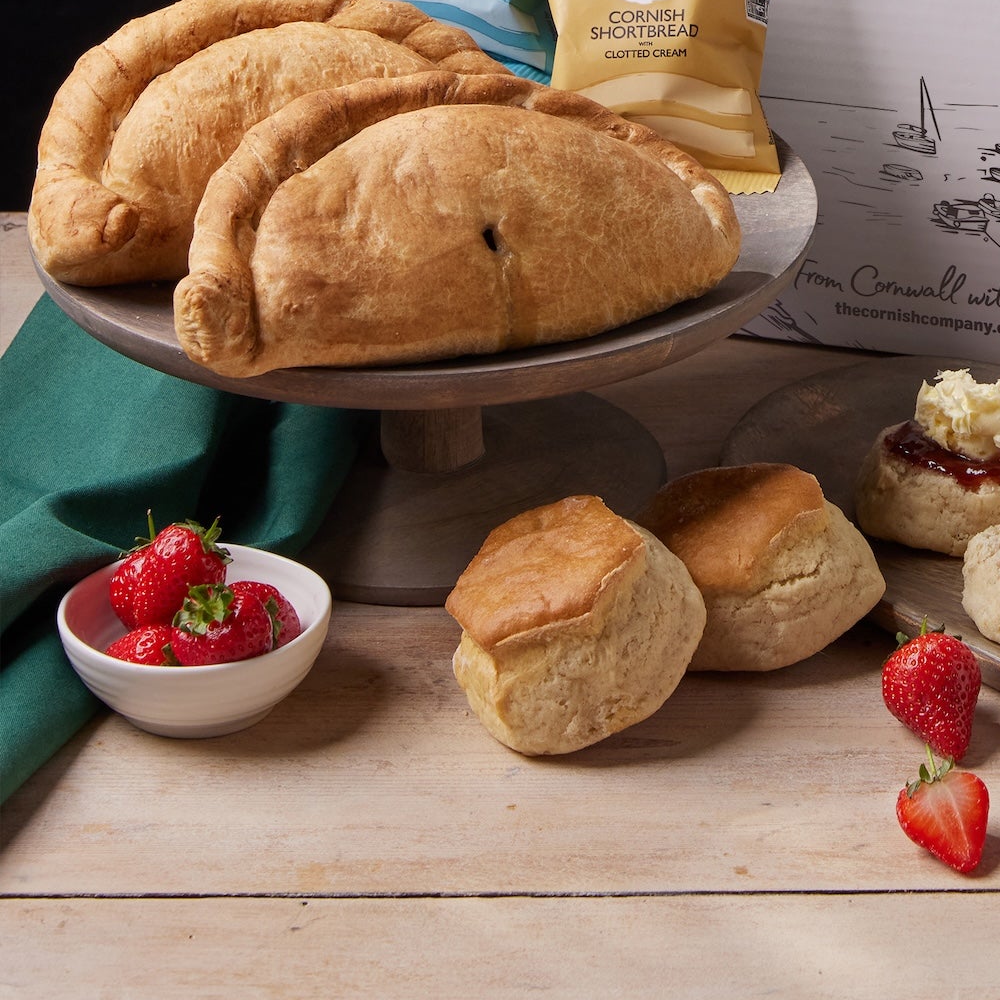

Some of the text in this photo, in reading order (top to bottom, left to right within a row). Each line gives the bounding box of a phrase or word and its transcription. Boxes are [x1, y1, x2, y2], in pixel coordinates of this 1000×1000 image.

[609, 9, 685, 24] CORNISH
[590, 23, 699, 40] SHORTBREAD
[604, 48, 687, 59] CLOTTED CREAM
[793, 259, 845, 292] From
[850, 264, 967, 304] Cornwall
